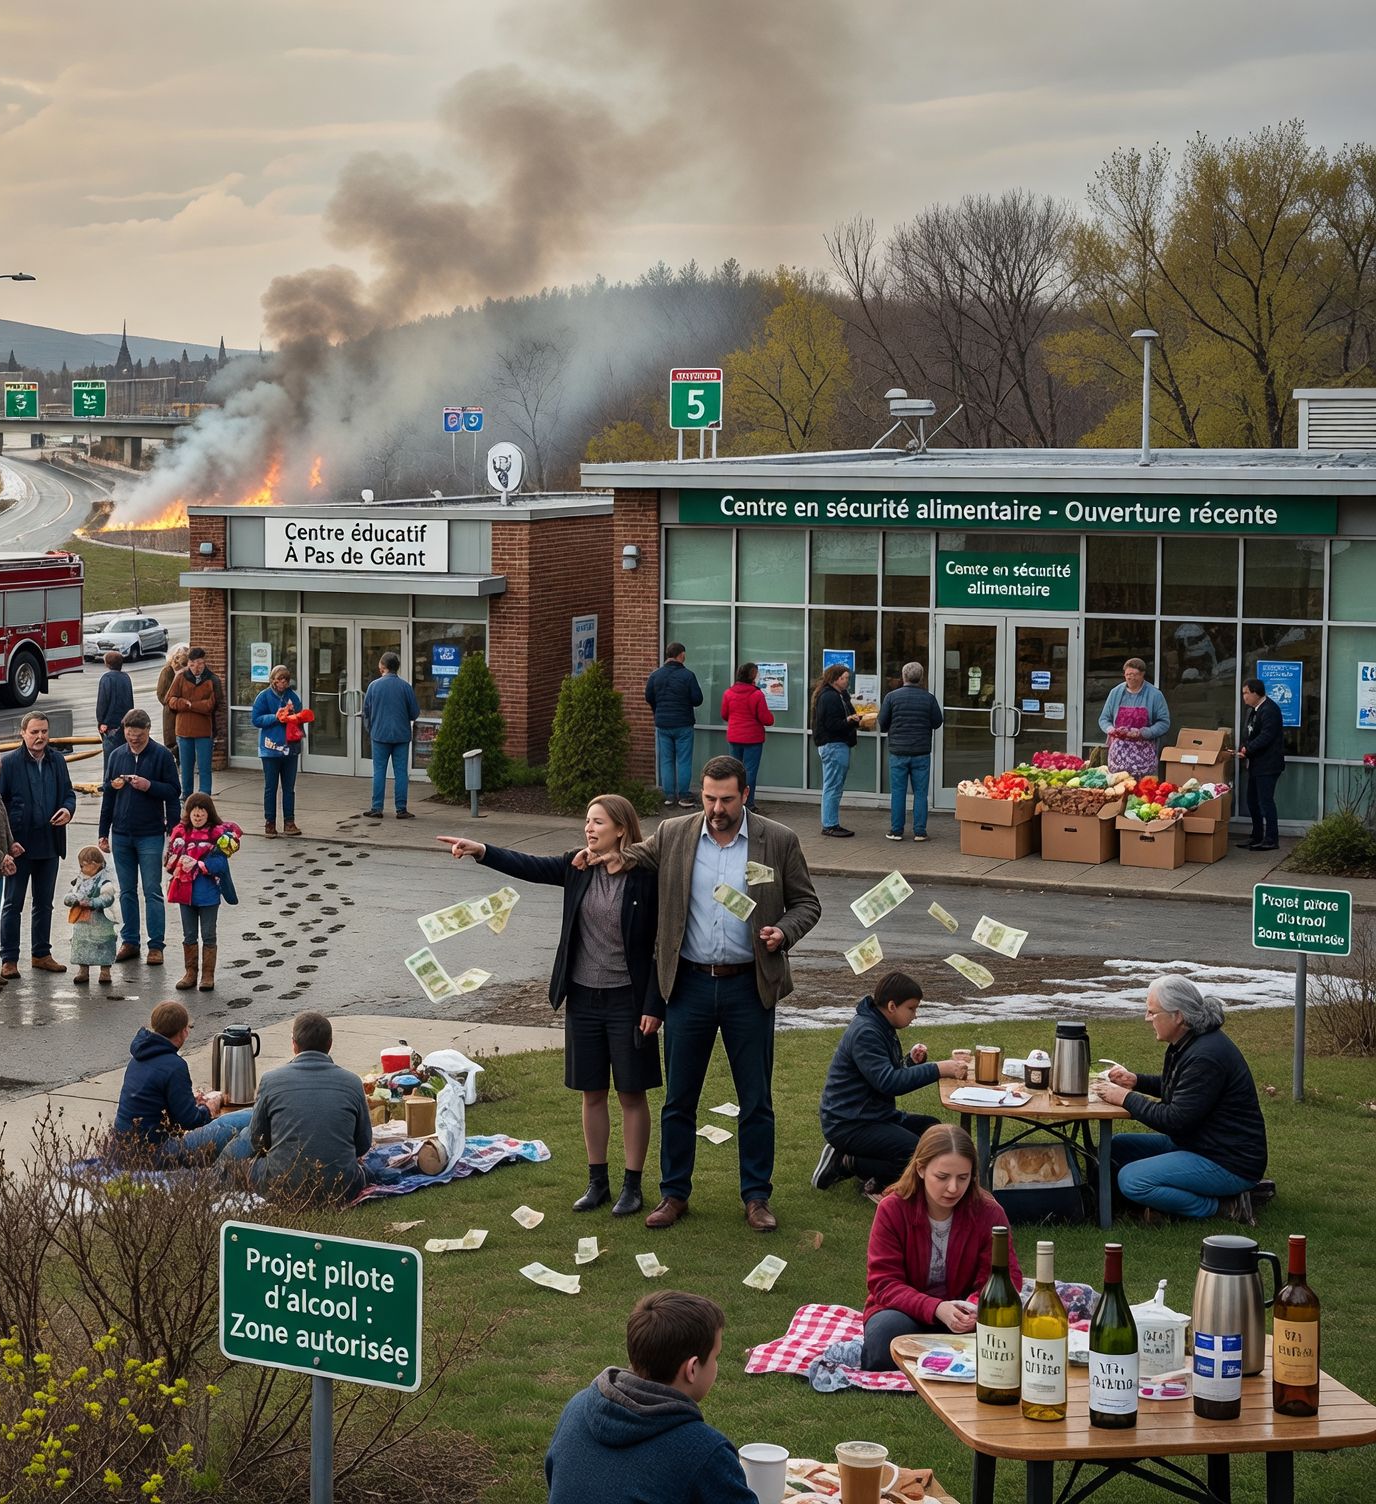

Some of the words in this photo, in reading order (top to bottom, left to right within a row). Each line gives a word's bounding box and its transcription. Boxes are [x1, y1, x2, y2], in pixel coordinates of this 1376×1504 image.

[687, 389, 705, 420] 5
[720, 495, 787, 518] Centre
[794, 500, 819, 518] en
[826, 497, 909, 519] sécurité
[916, 498, 1042, 521] alimentaire
[1065, 500, 1181, 523] Ouverture
[1190, 501, 1278, 525] récente
[284, 522, 345, 541] Centre
[351, 522, 427, 543] éducatif
[284, 542, 299, 563] À
[304, 546, 335, 564] Pas
[341, 546, 364, 565] de
[370, 546, 426, 567] Géant
[967, 580, 1051, 597] alimentaire
[245, 1247, 317, 1284] Projet
[324, 1260, 395, 1294] pilote
[264, 1284, 358, 1322] d'alcool
[229, 1311, 289, 1345] Zone
[296, 1330, 409, 1366] autorisée
